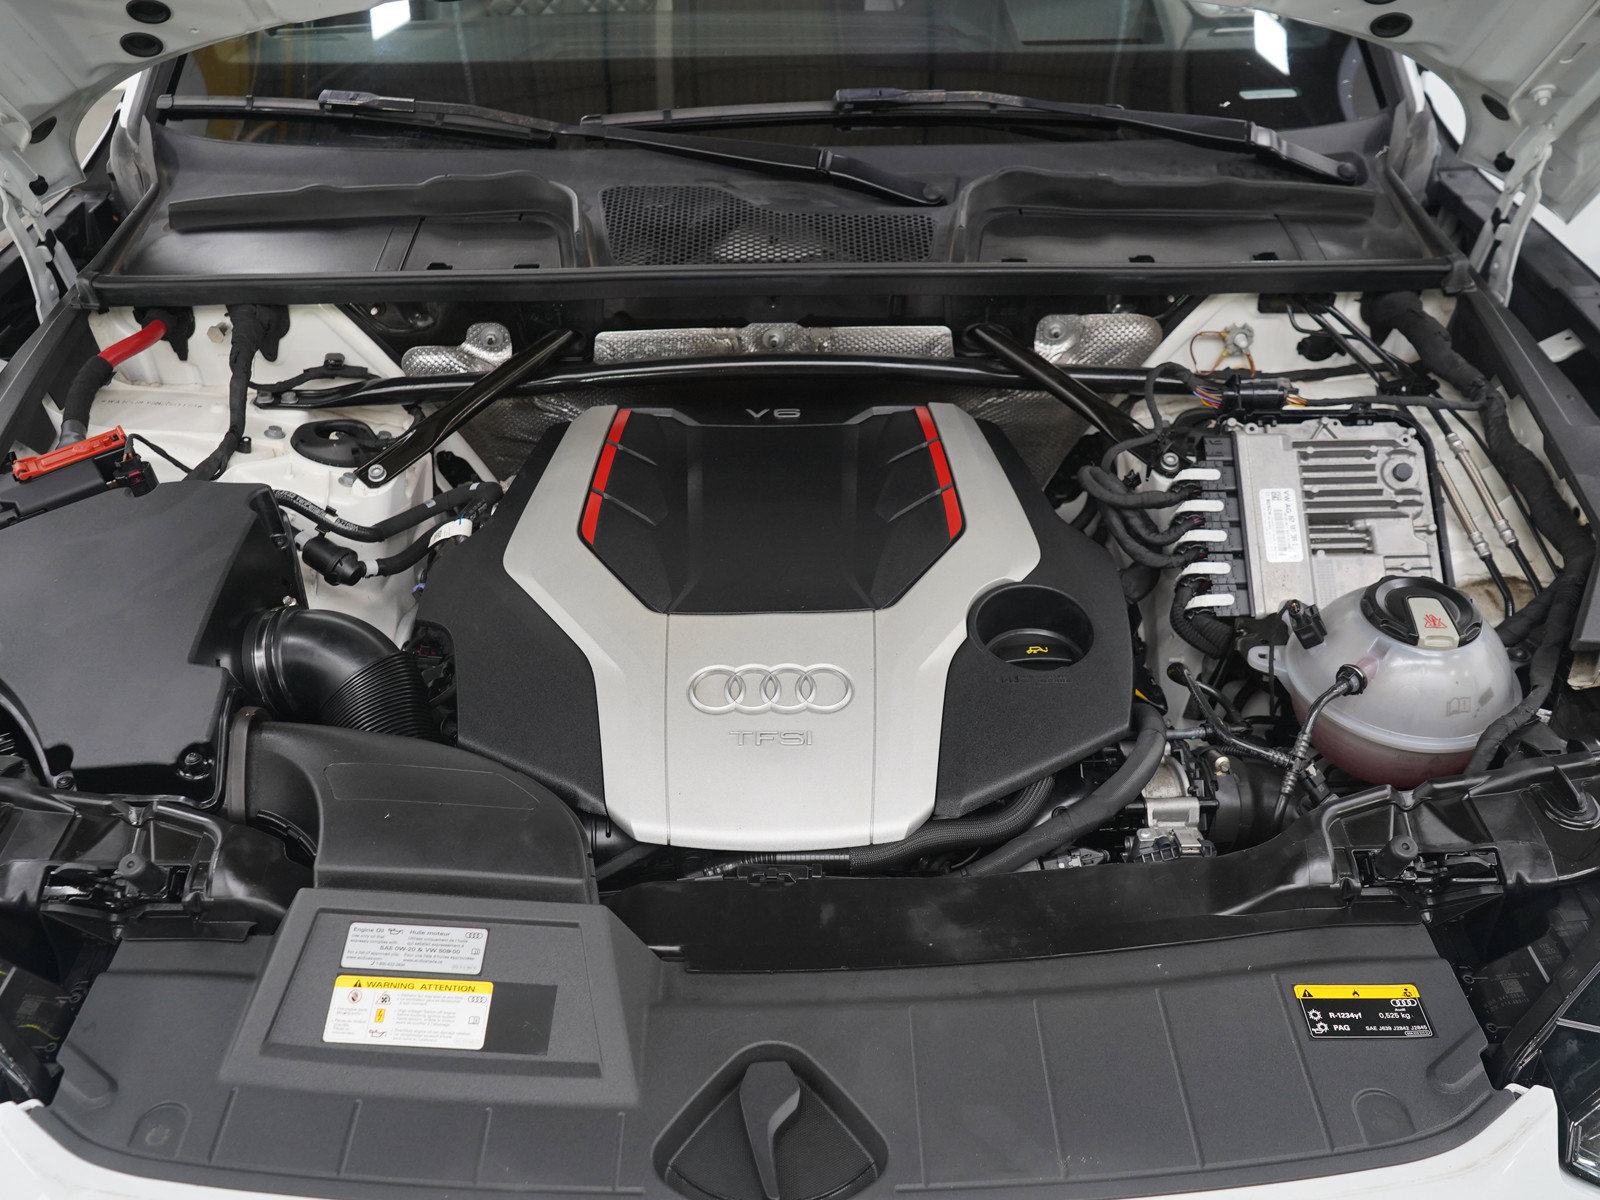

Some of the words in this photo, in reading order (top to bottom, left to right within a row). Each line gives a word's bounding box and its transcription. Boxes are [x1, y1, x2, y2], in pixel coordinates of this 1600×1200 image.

[745, 408, 801, 418] V6
[729, 730, 813, 747] TFSI
[366, 981, 415, 989] WARNING
[419, 983, 476, 992] ATTENTION
[1329, 1012, 1362, 1020] R-1234yf
[1400, 1012, 1411, 1020] kg
